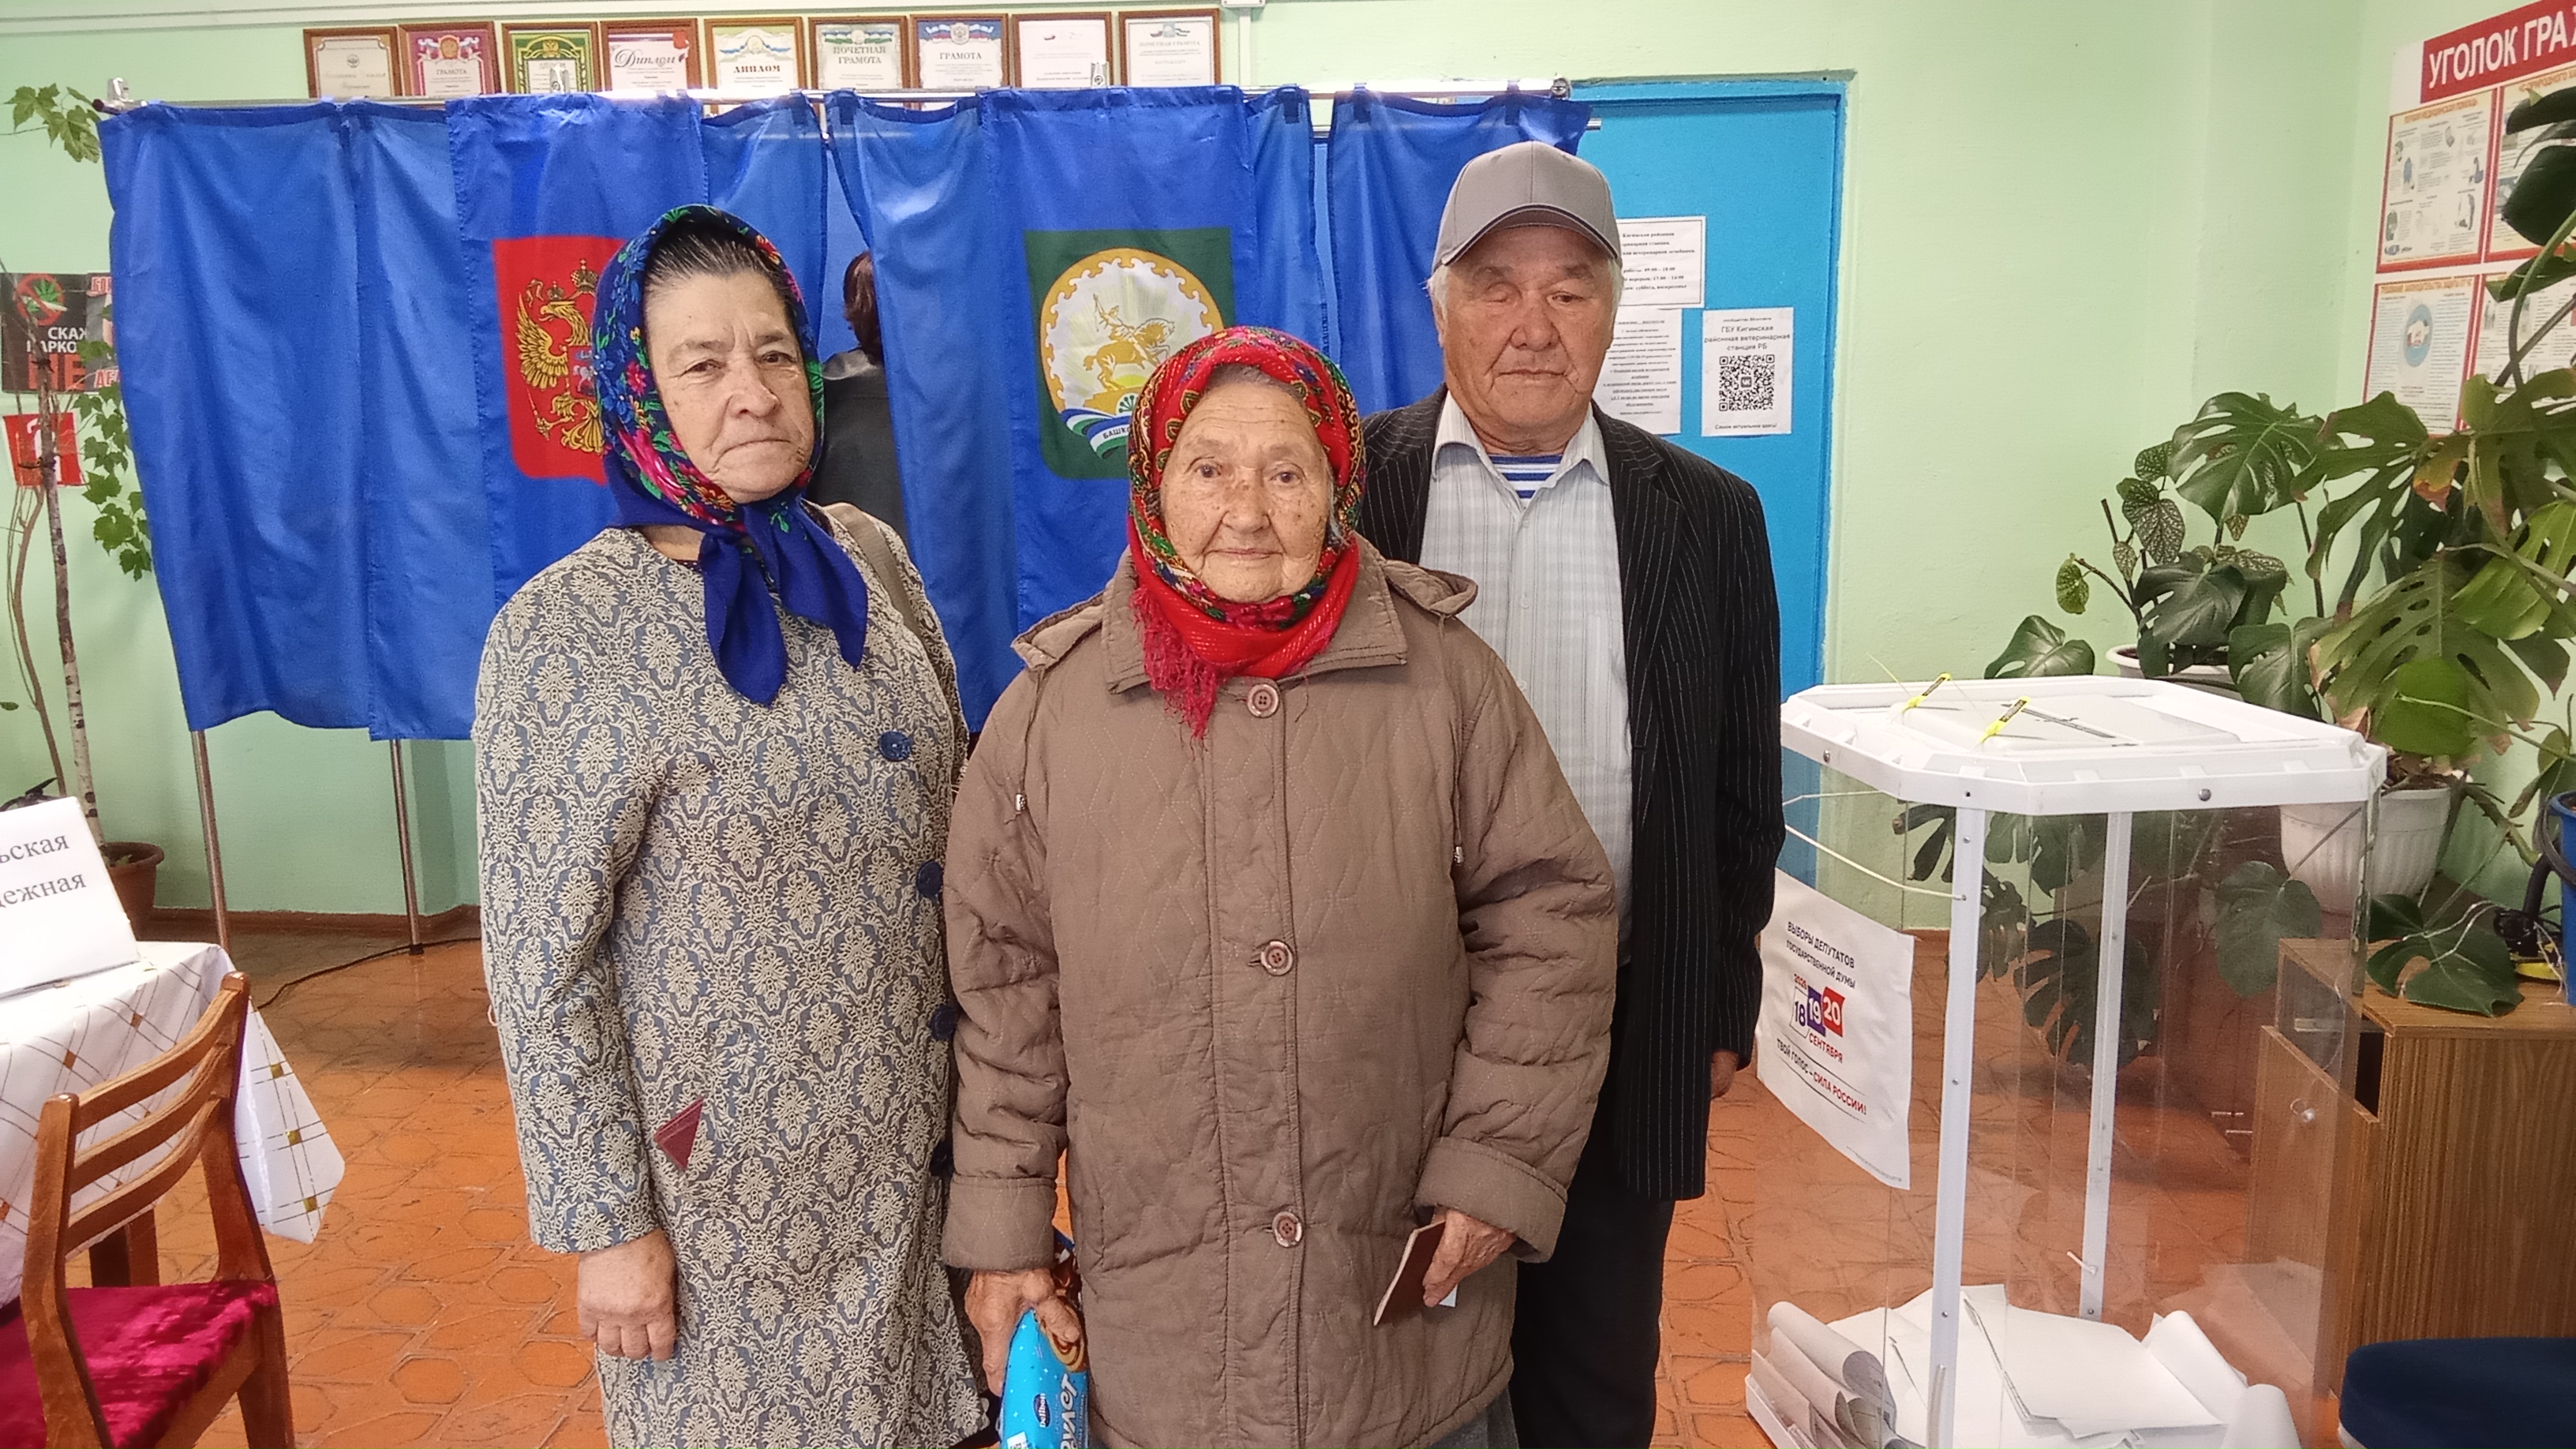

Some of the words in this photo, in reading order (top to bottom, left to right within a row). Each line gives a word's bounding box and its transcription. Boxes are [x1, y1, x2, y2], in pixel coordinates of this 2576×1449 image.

[614, 48, 676, 68] Диплом
[833, 46, 886, 54] ПОЧЕТНАЯ
[2428, 26, 2518, 88] УГОЛОК
[733, 65, 781, 73] ДИПЛОМ
[1704, 335, 1739, 343] районная
[1787, 921, 1814, 945] ВЫБОРЫ
[1814, 938, 1855, 968] ДЕПУТАТОВ
[1786, 940, 1836, 978] ГОСУДАРСТВЕННОЙ
[1835, 971, 1855, 989] ДУМЫ
[1795, 1001, 1806, 1027] 18
[1809, 998, 1822, 1024] 19
[1823, 996, 1841, 1026] 20
[1809, 1032, 1844, 1064] СЕНТЯБРЯ
[1777, 1038, 1791, 1058] ТВОЙ
[1791, 1051, 1808, 1073] ГОЛОС
[1813, 1071, 1832, 1092] СИЛА
[1832, 1085, 1866, 1115] РОССИИ!
